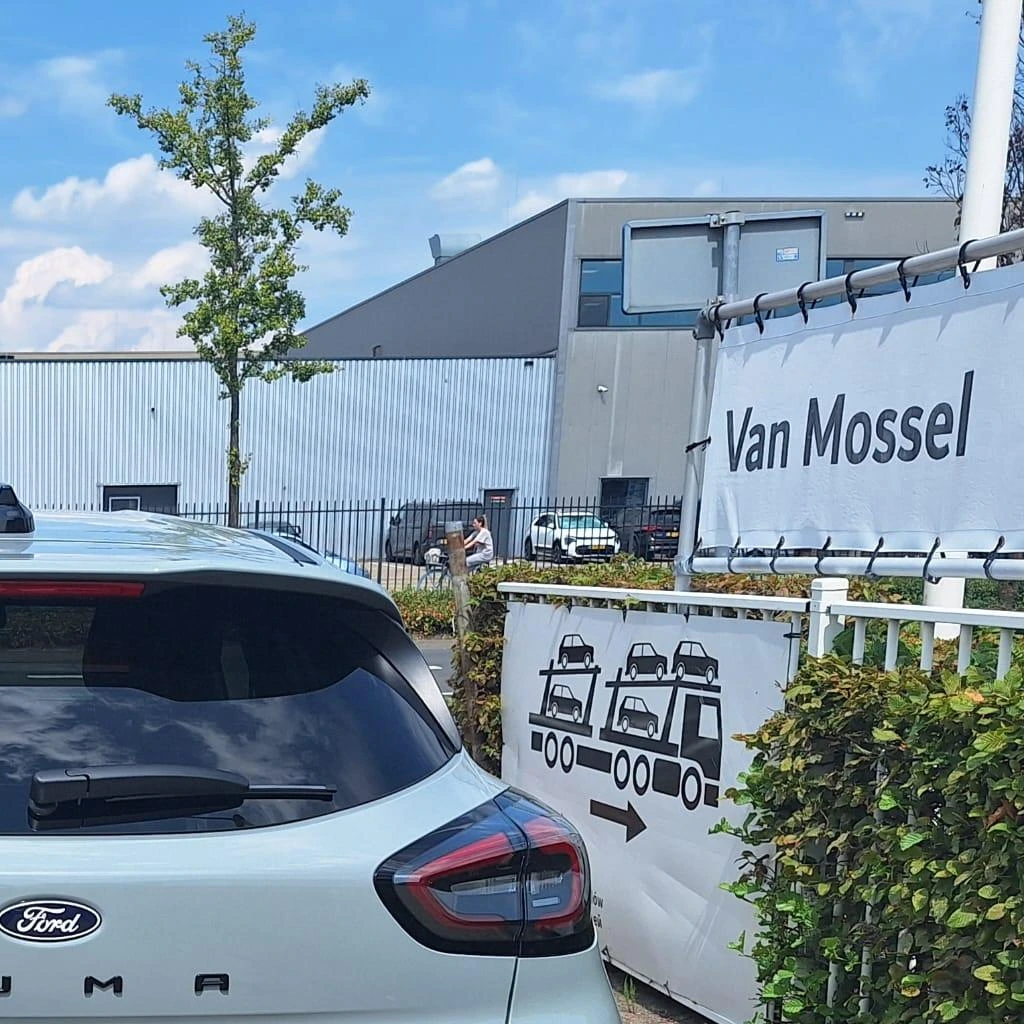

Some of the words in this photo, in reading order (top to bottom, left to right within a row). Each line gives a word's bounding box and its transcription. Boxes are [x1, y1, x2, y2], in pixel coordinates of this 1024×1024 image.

[726, 407, 791, 472] Van
[803, 370, 975, 467] Mossel
[16, 906, 82, 933] Ford
